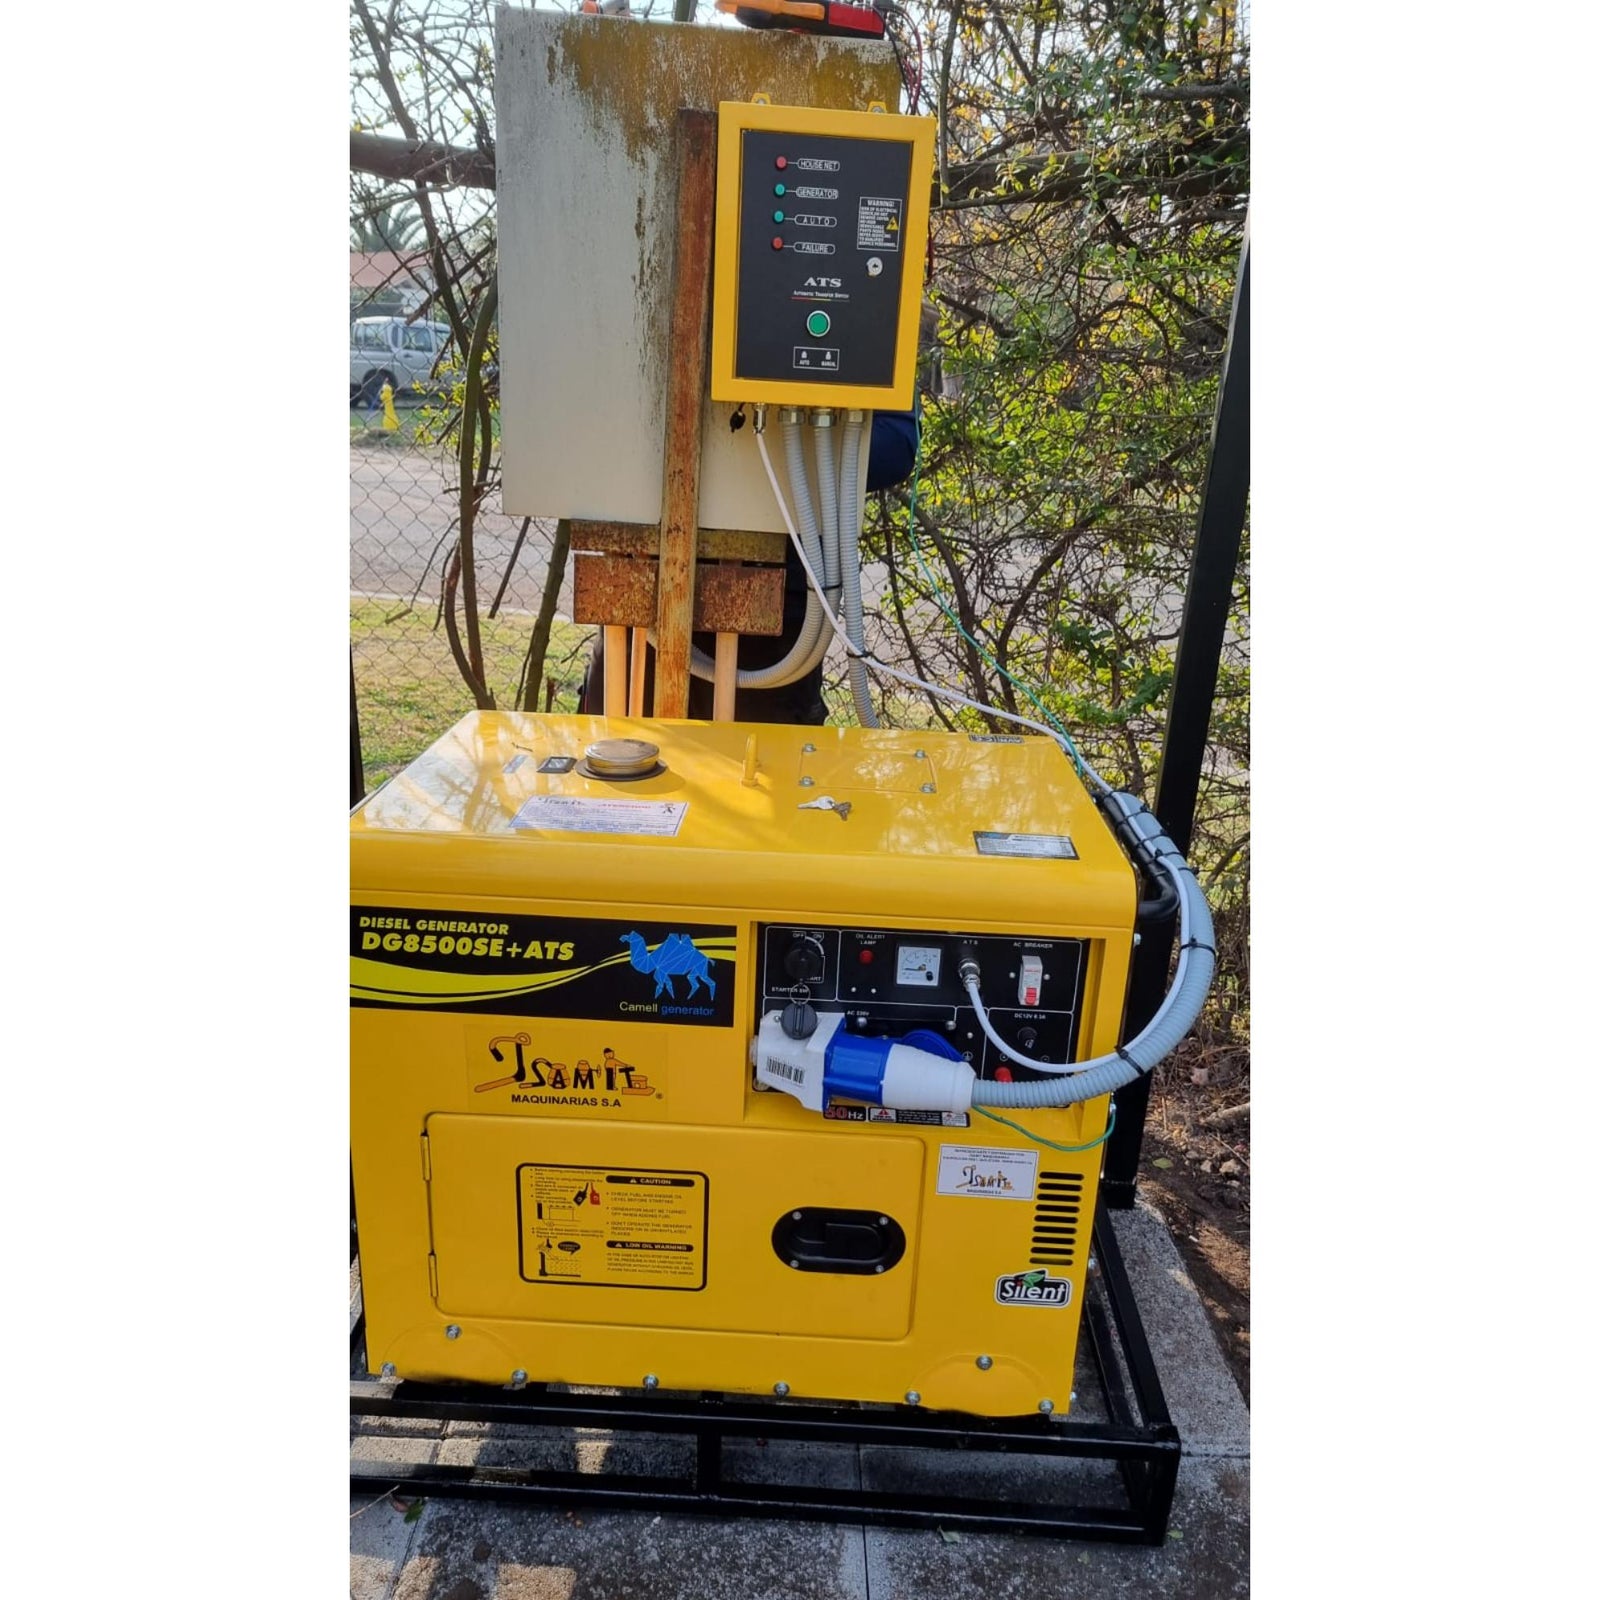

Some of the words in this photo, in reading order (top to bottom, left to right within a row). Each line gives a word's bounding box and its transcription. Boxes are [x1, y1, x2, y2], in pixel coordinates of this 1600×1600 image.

[801, 162, 822, 170] HOUSE
[798, 188, 838, 199] GENERATOR
[802, 243, 828, 252] FAILURE
[804, 277, 842, 287] ATS
[360, 916, 411, 930] DIESEL
[416, 919, 510, 934] GENERATOR
[362, 932, 575, 960] DG8500SE+ATS
[620, 1001, 658, 1013] Camell
[661, 1002, 715, 1016] generator
[511, 1094, 598, 1106] MAQUINARIAS
[601, 1098, 621, 1108] S.A
[1002, 1282, 1065, 1300] Silent
